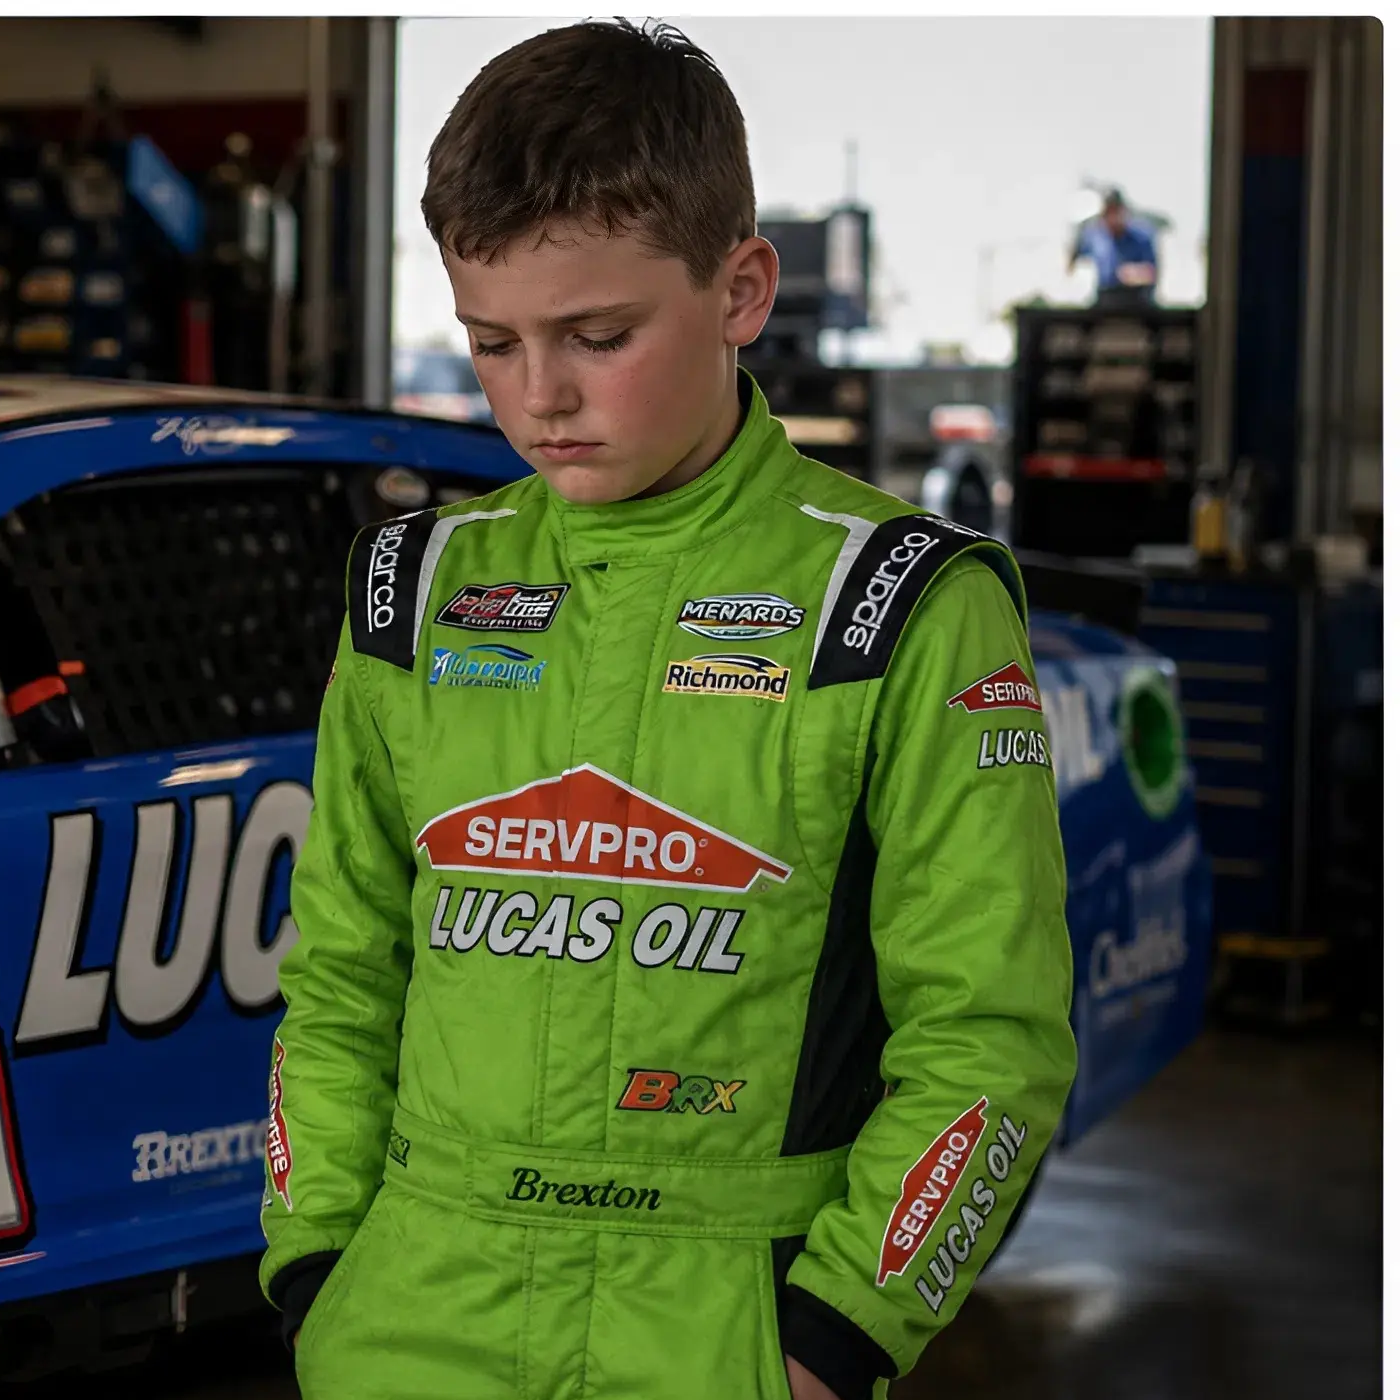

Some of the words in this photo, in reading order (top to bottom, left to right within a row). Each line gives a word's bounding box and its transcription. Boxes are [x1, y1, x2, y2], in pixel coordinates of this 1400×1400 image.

[368, 524, 408, 632] sparco
[679, 600, 806, 627] MENARDS
[843, 532, 940, 656] sparco
[666, 663, 790, 695] Richmond
[463, 814, 698, 876] SERVPRO
[428, 885, 624, 964] LUCAS
[631, 901, 747, 974] OIL
[505, 1166, 662, 1212] Brexton
[892, 1130, 970, 1251] SERVPRO
[915, 1176, 996, 1317] LUCAS
[985, 1112, 1028, 1183] OIL
